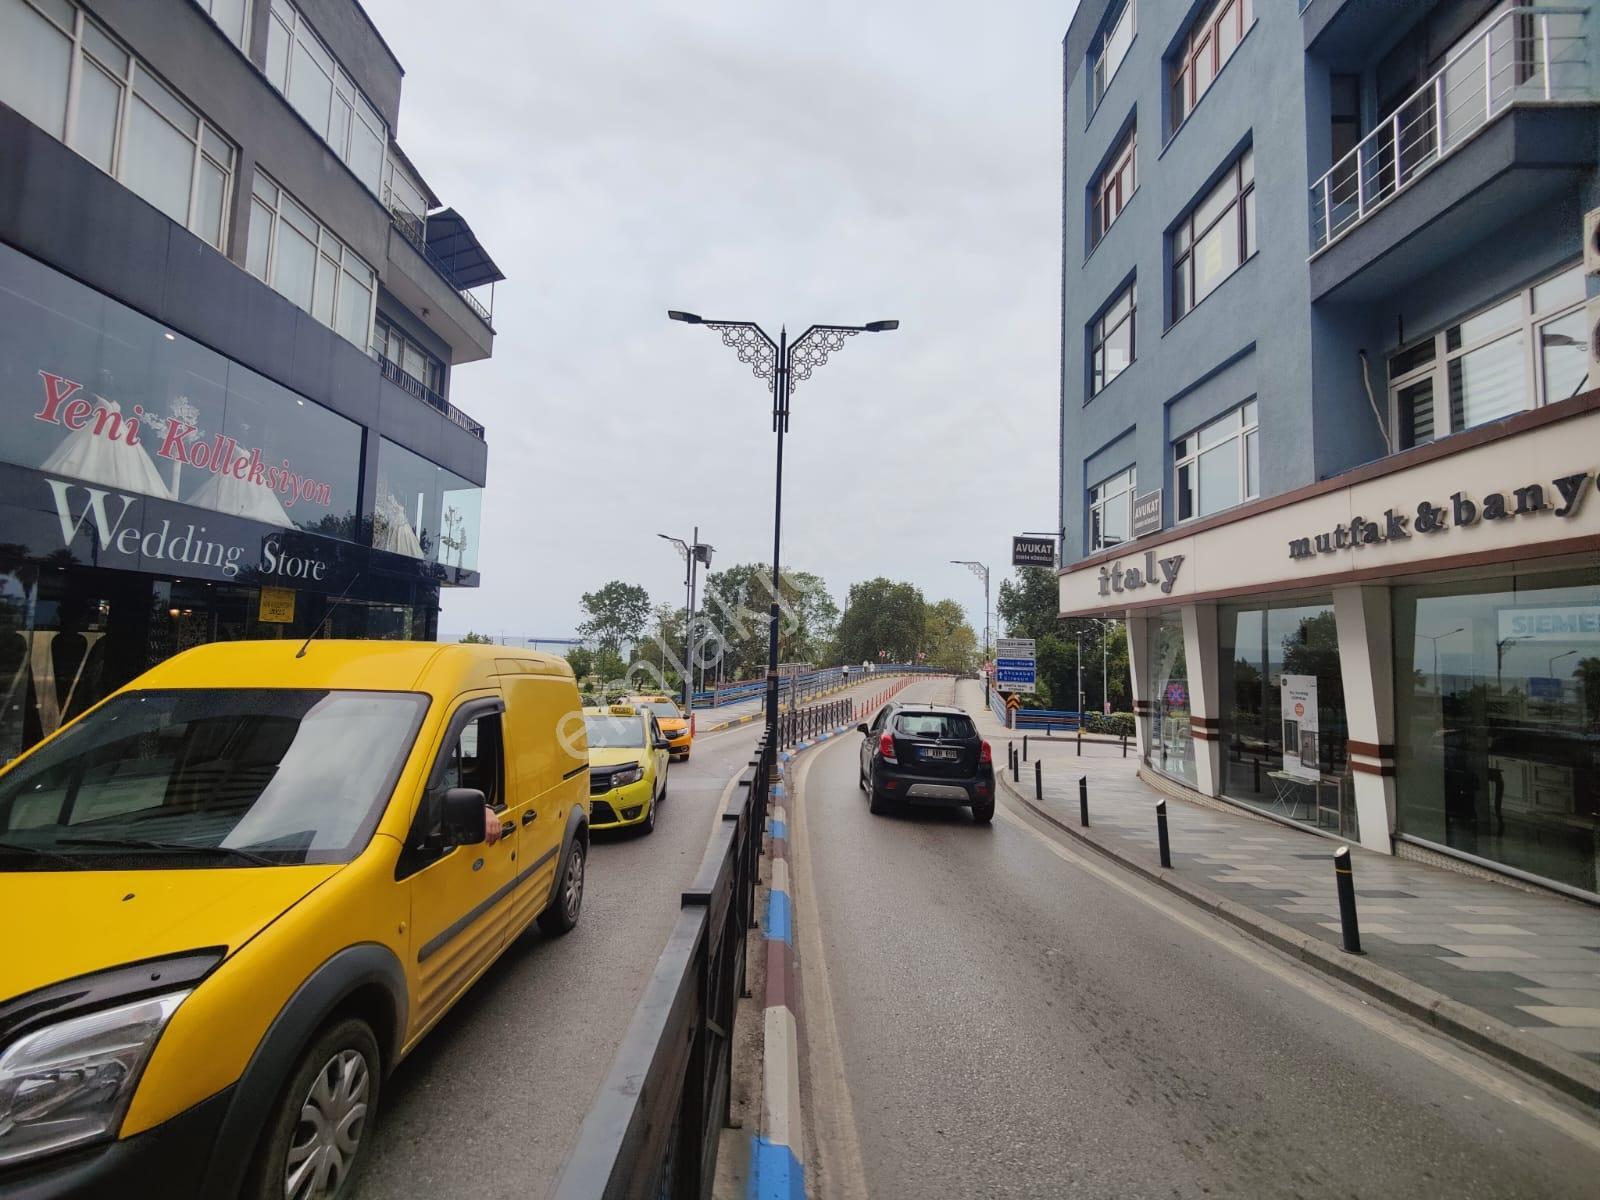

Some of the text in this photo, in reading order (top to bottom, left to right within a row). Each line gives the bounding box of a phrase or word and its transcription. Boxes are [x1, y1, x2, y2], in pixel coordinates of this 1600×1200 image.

[34, 369, 333, 507] Yeni Kolleksiyon
[44, 478, 326, 581] Wedding Store
[1015, 543, 1053, 554] AVUKAT
[1098, 471, 1600, 596] italy mutfak&bany
[1135, 499, 1159, 518] AVUKAT
